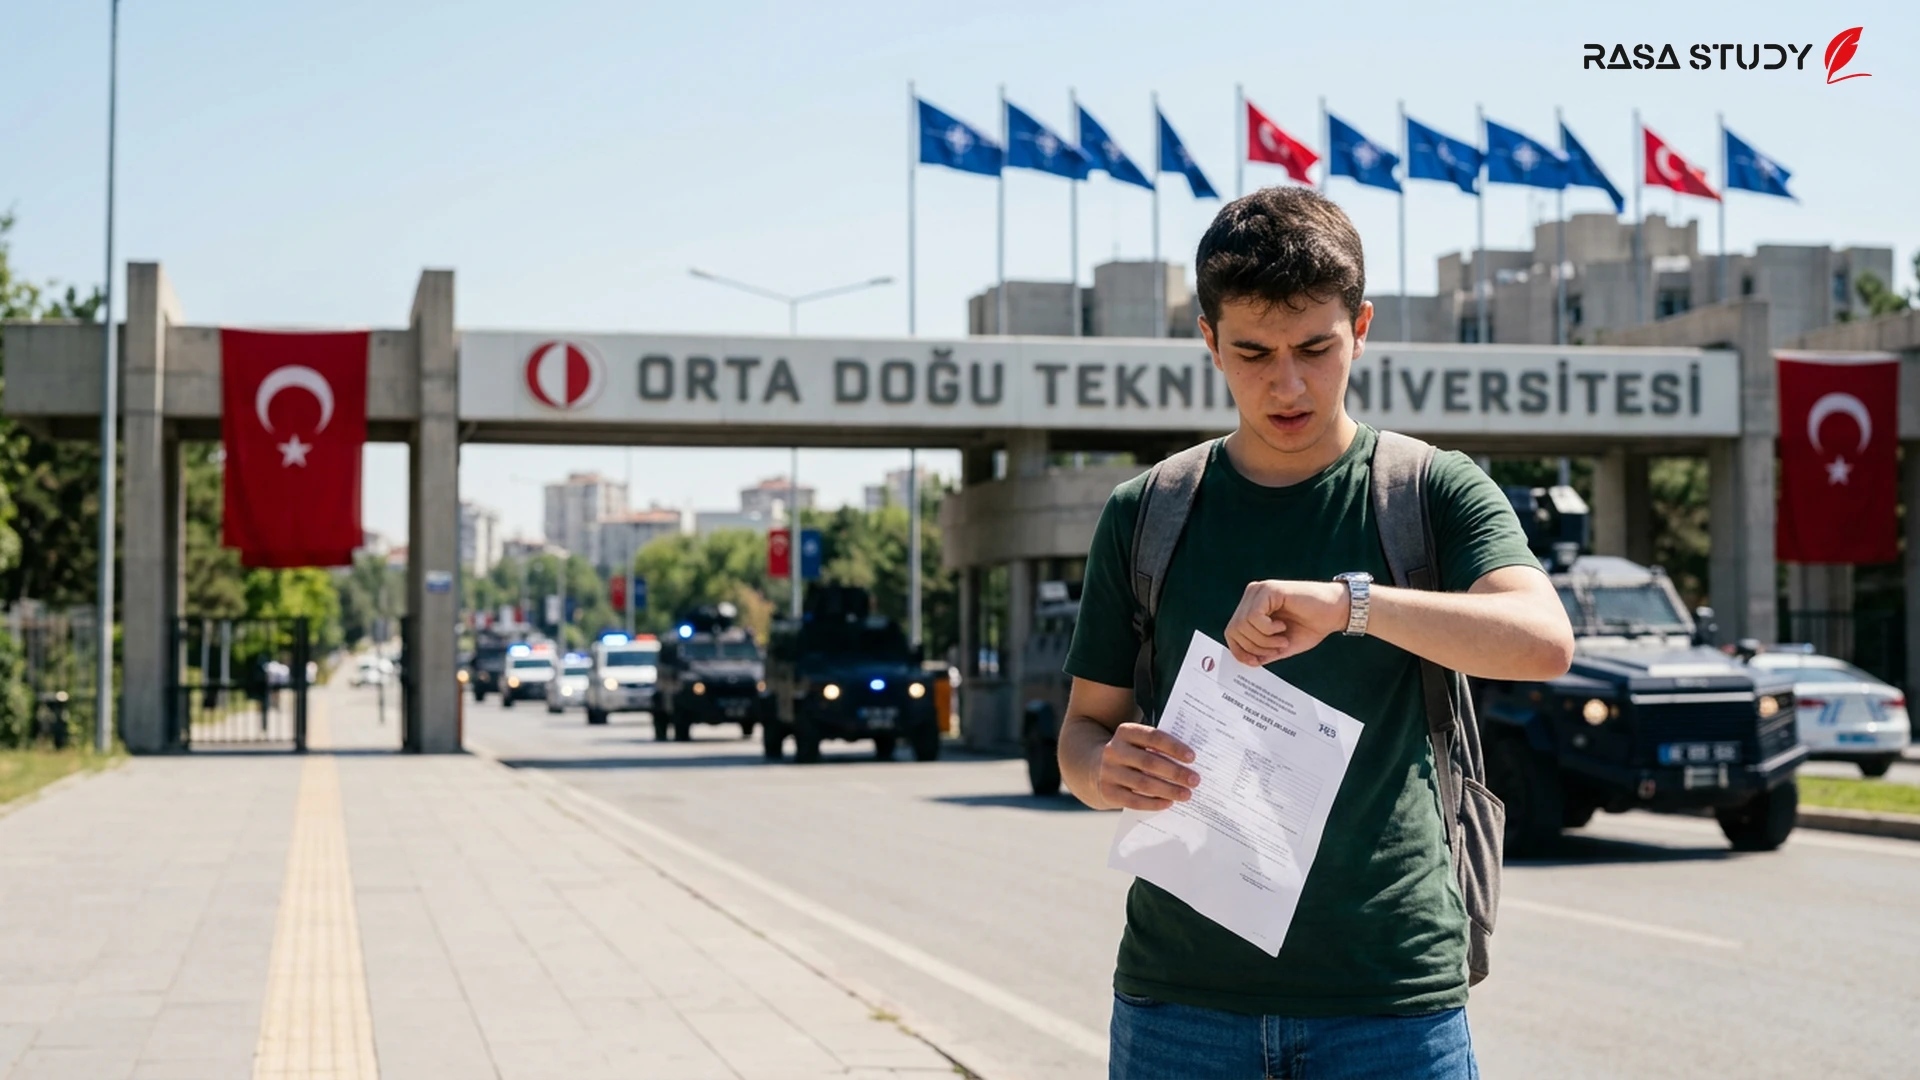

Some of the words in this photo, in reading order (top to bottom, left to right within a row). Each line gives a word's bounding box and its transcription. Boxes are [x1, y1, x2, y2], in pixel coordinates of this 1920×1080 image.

[637, 354, 803, 404] ORTA
[834, 348, 1005, 406] DOĞU
[1345, 357, 1702, 417] NİVERSİTESİ
